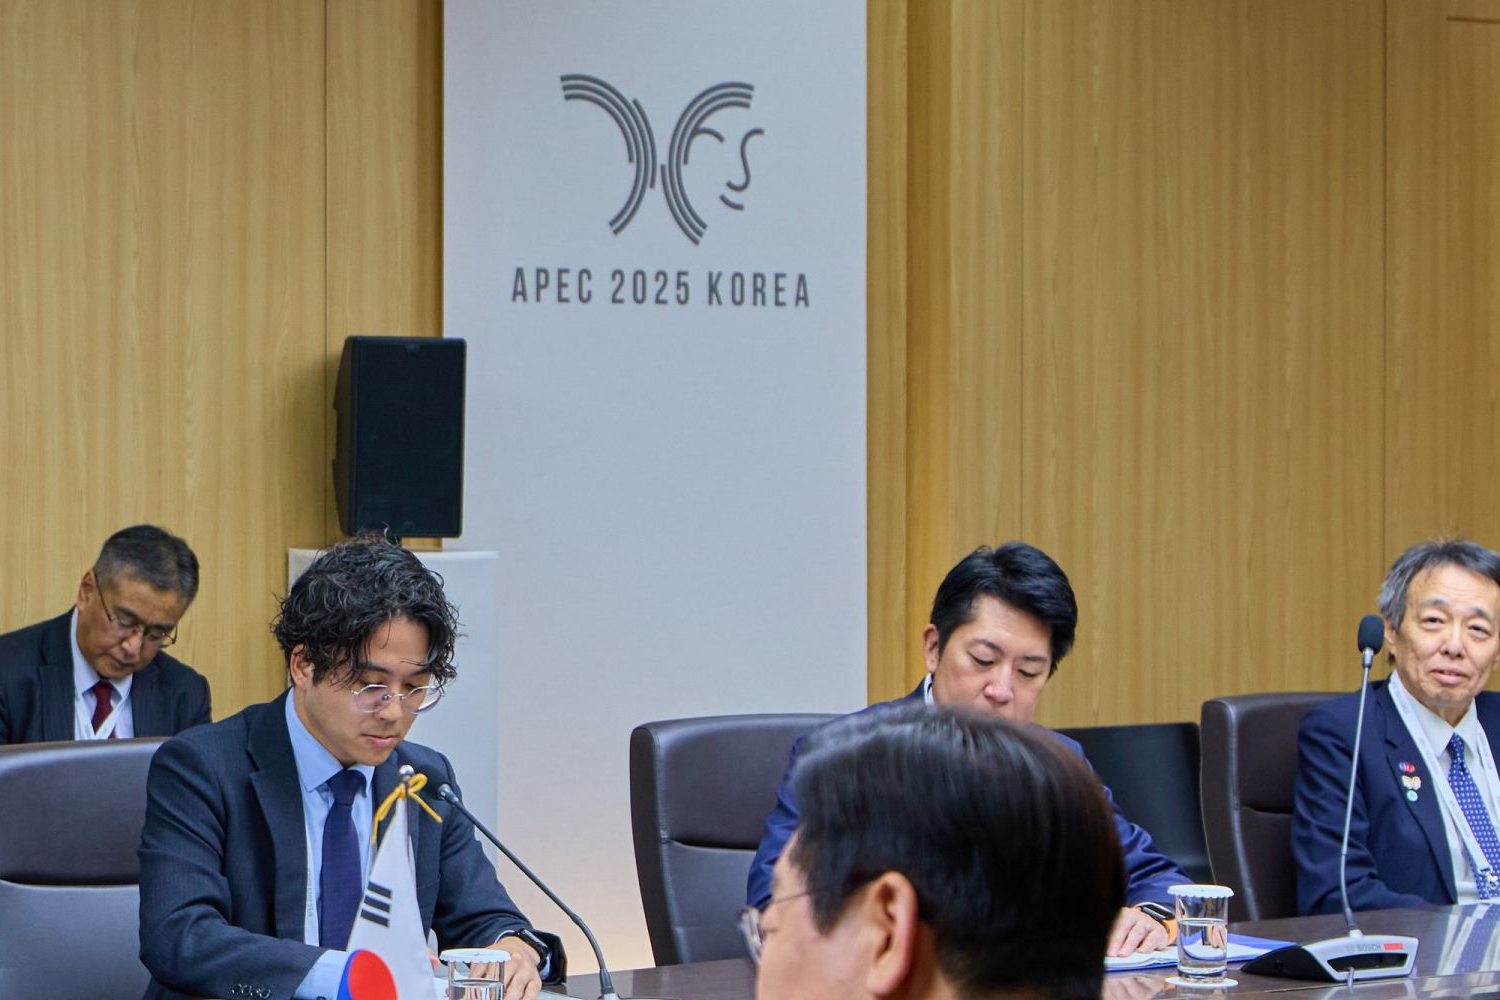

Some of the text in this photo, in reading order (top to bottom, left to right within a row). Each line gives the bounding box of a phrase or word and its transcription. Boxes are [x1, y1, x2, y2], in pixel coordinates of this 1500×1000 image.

[511, 267, 810, 307] APEC 2025 KOREA
